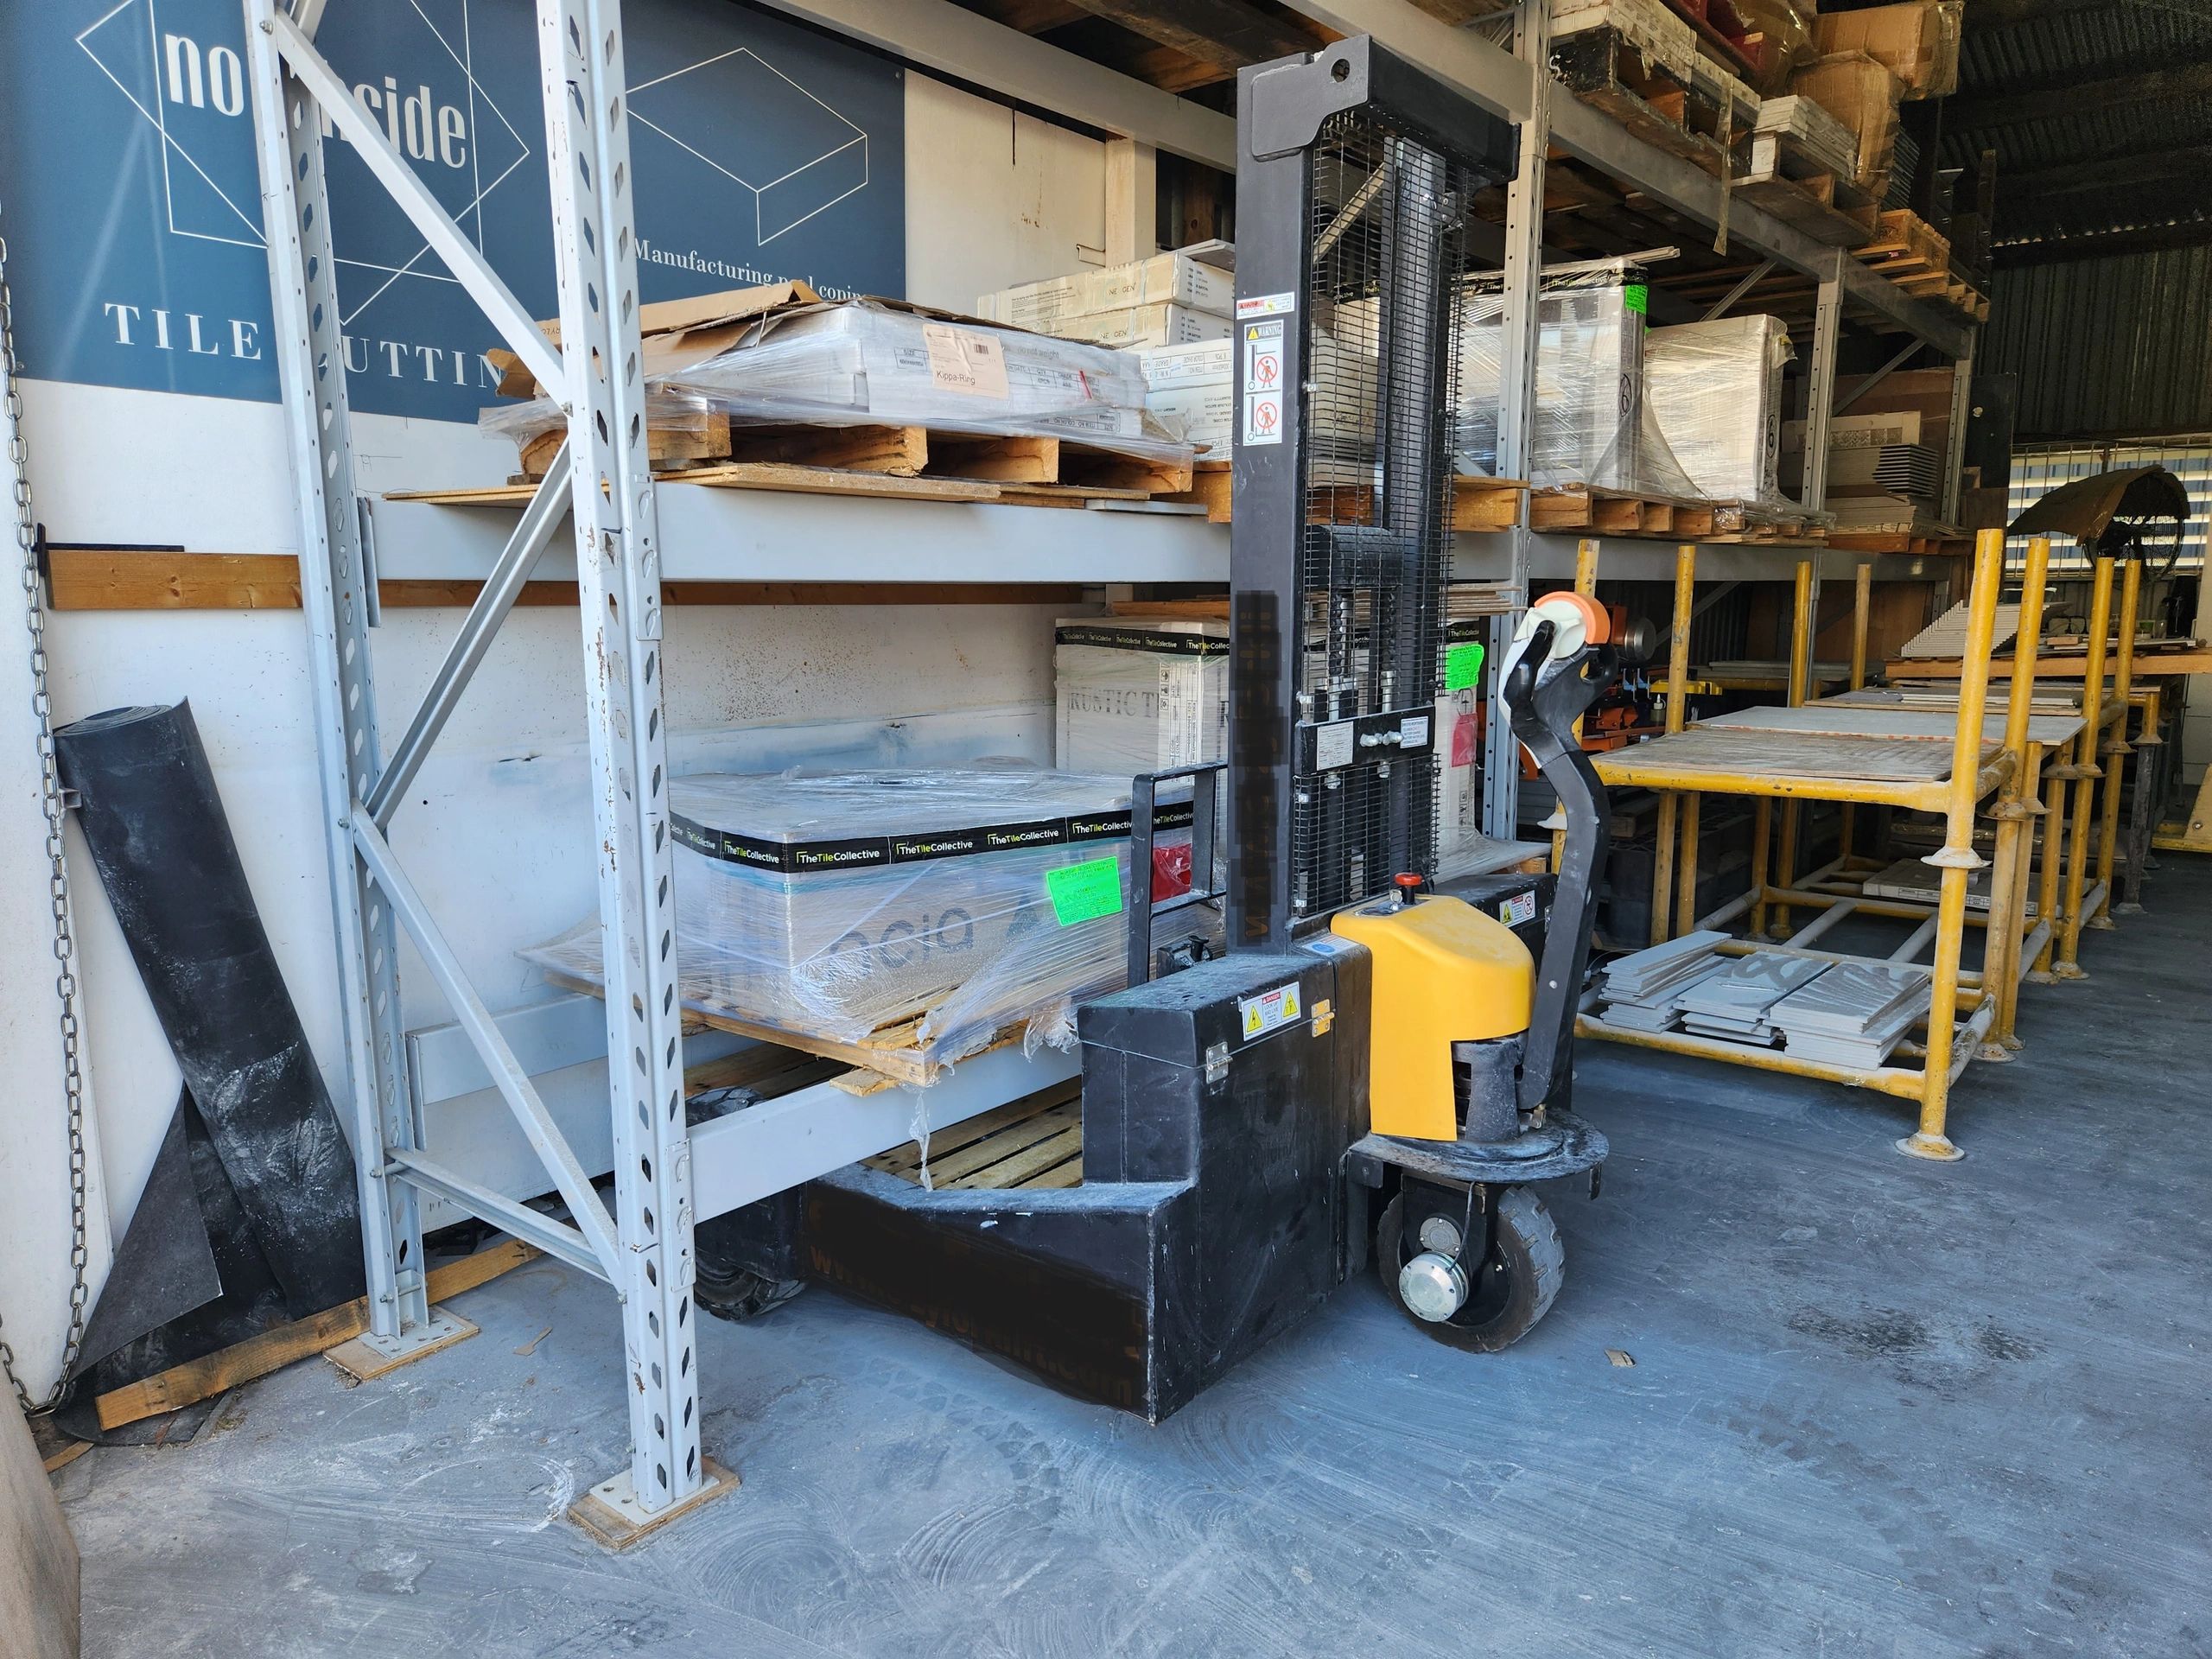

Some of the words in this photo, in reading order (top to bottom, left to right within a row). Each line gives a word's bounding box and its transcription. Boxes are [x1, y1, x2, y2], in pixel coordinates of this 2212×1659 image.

[105, 303, 261, 360] TILE
[318, 335, 503, 388] UTTIN
[936, 370, 976, 386] Kippa-Ring
[1188, 641, 1230, 650] TheTileCollec
[1071, 691, 1137, 716] RUSTIC
[1142, 691, 1159, 718] T
[1154, 810, 1193, 824] heTileCollectiv
[1075, 820, 1132, 835] TheTileCollectiv
[990, 829, 1059, 846] TheTileCollective
[726, 843, 779, 864] TheTileCollective
[899, 840, 973, 855] TheTileCollective
[800, 849, 880, 864] TheTileCollective
